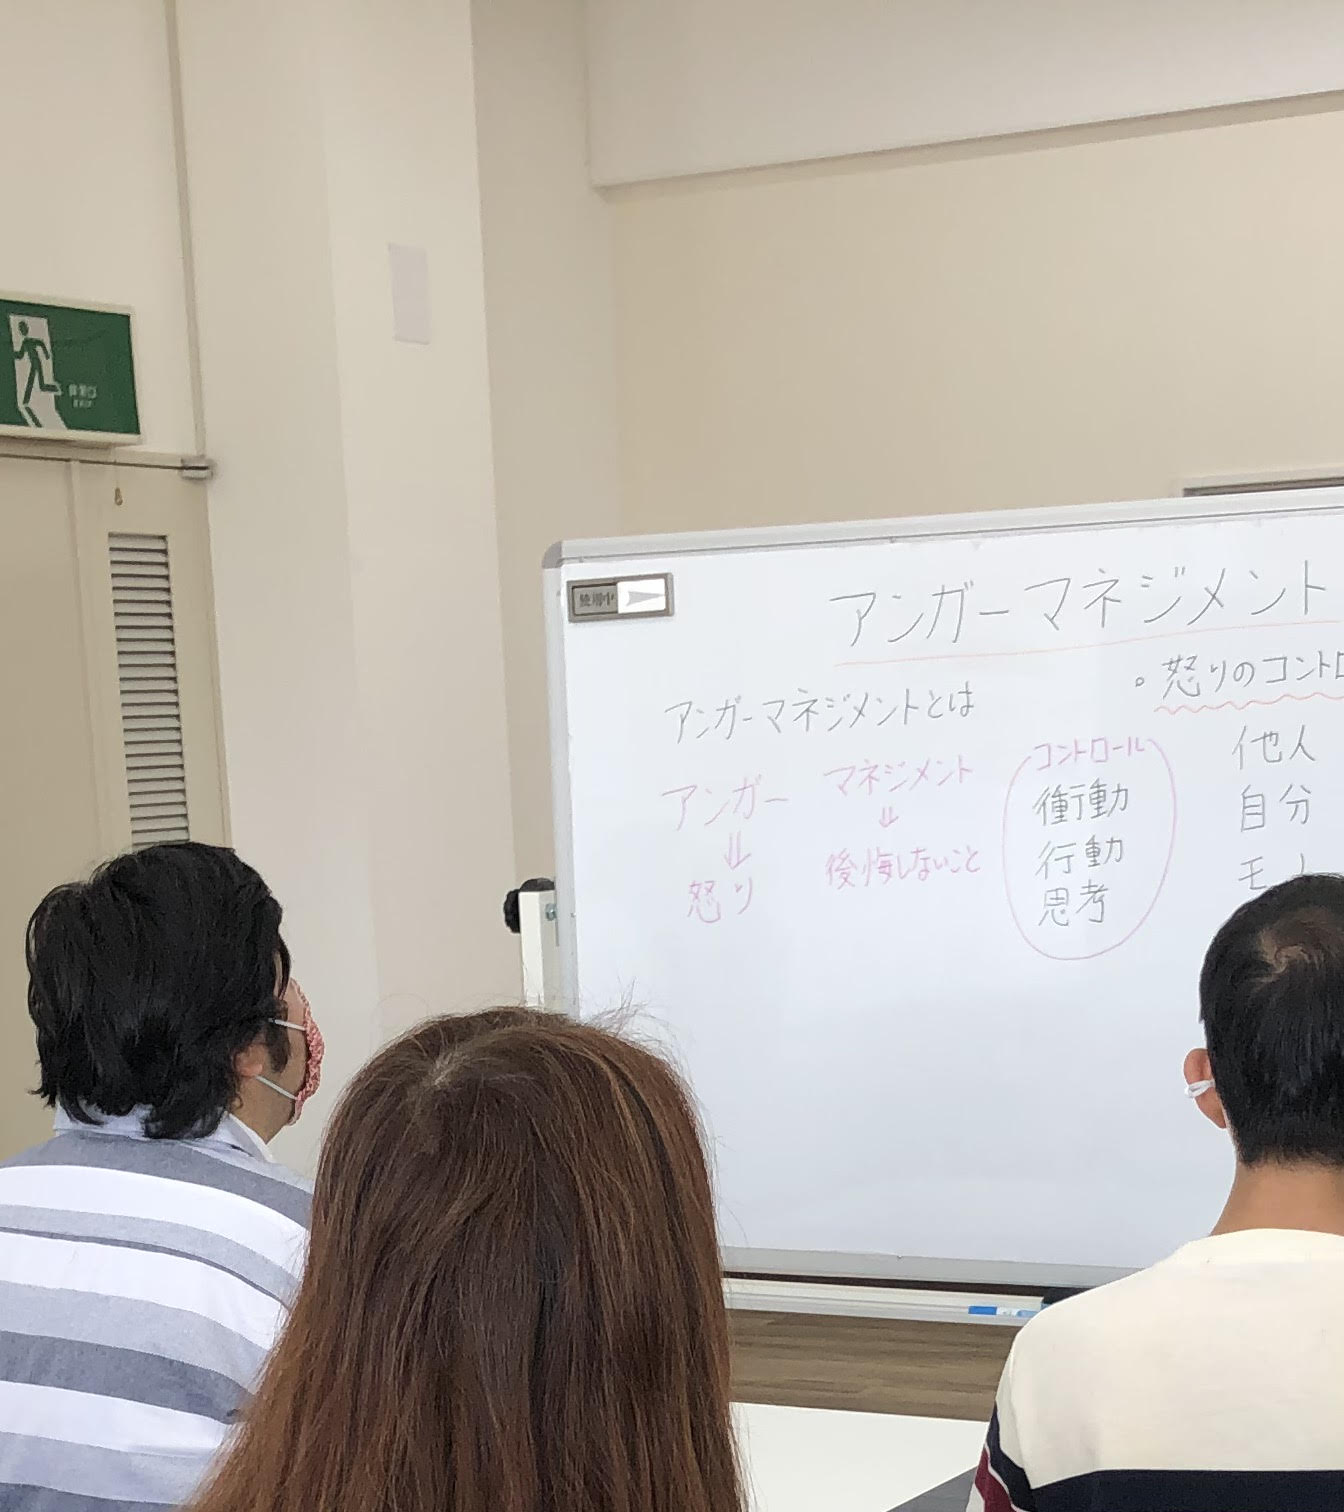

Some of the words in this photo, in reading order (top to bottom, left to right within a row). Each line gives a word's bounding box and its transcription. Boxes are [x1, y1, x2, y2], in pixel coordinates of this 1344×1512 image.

[829, 558, 1327, 648] アンガーマネジメント
[664, 680, 975, 745] アンガーマネジメントとは
[1033, 736, 1146, 771] コントロール
[1231, 724, 1317, 770] 他人
[823, 754, 974, 796] マネジメント
[661, 773, 789, 831] アンガー
[1032, 777, 1130, 827] 衝動
[1240, 783, 1312, 833] 自分
[823, 845, 982, 890] 後悔しないこと
[1034, 834, 1124, 881] 行動
[686, 876, 753, 924] 怒り
[1037, 878, 1110, 927] 思考
